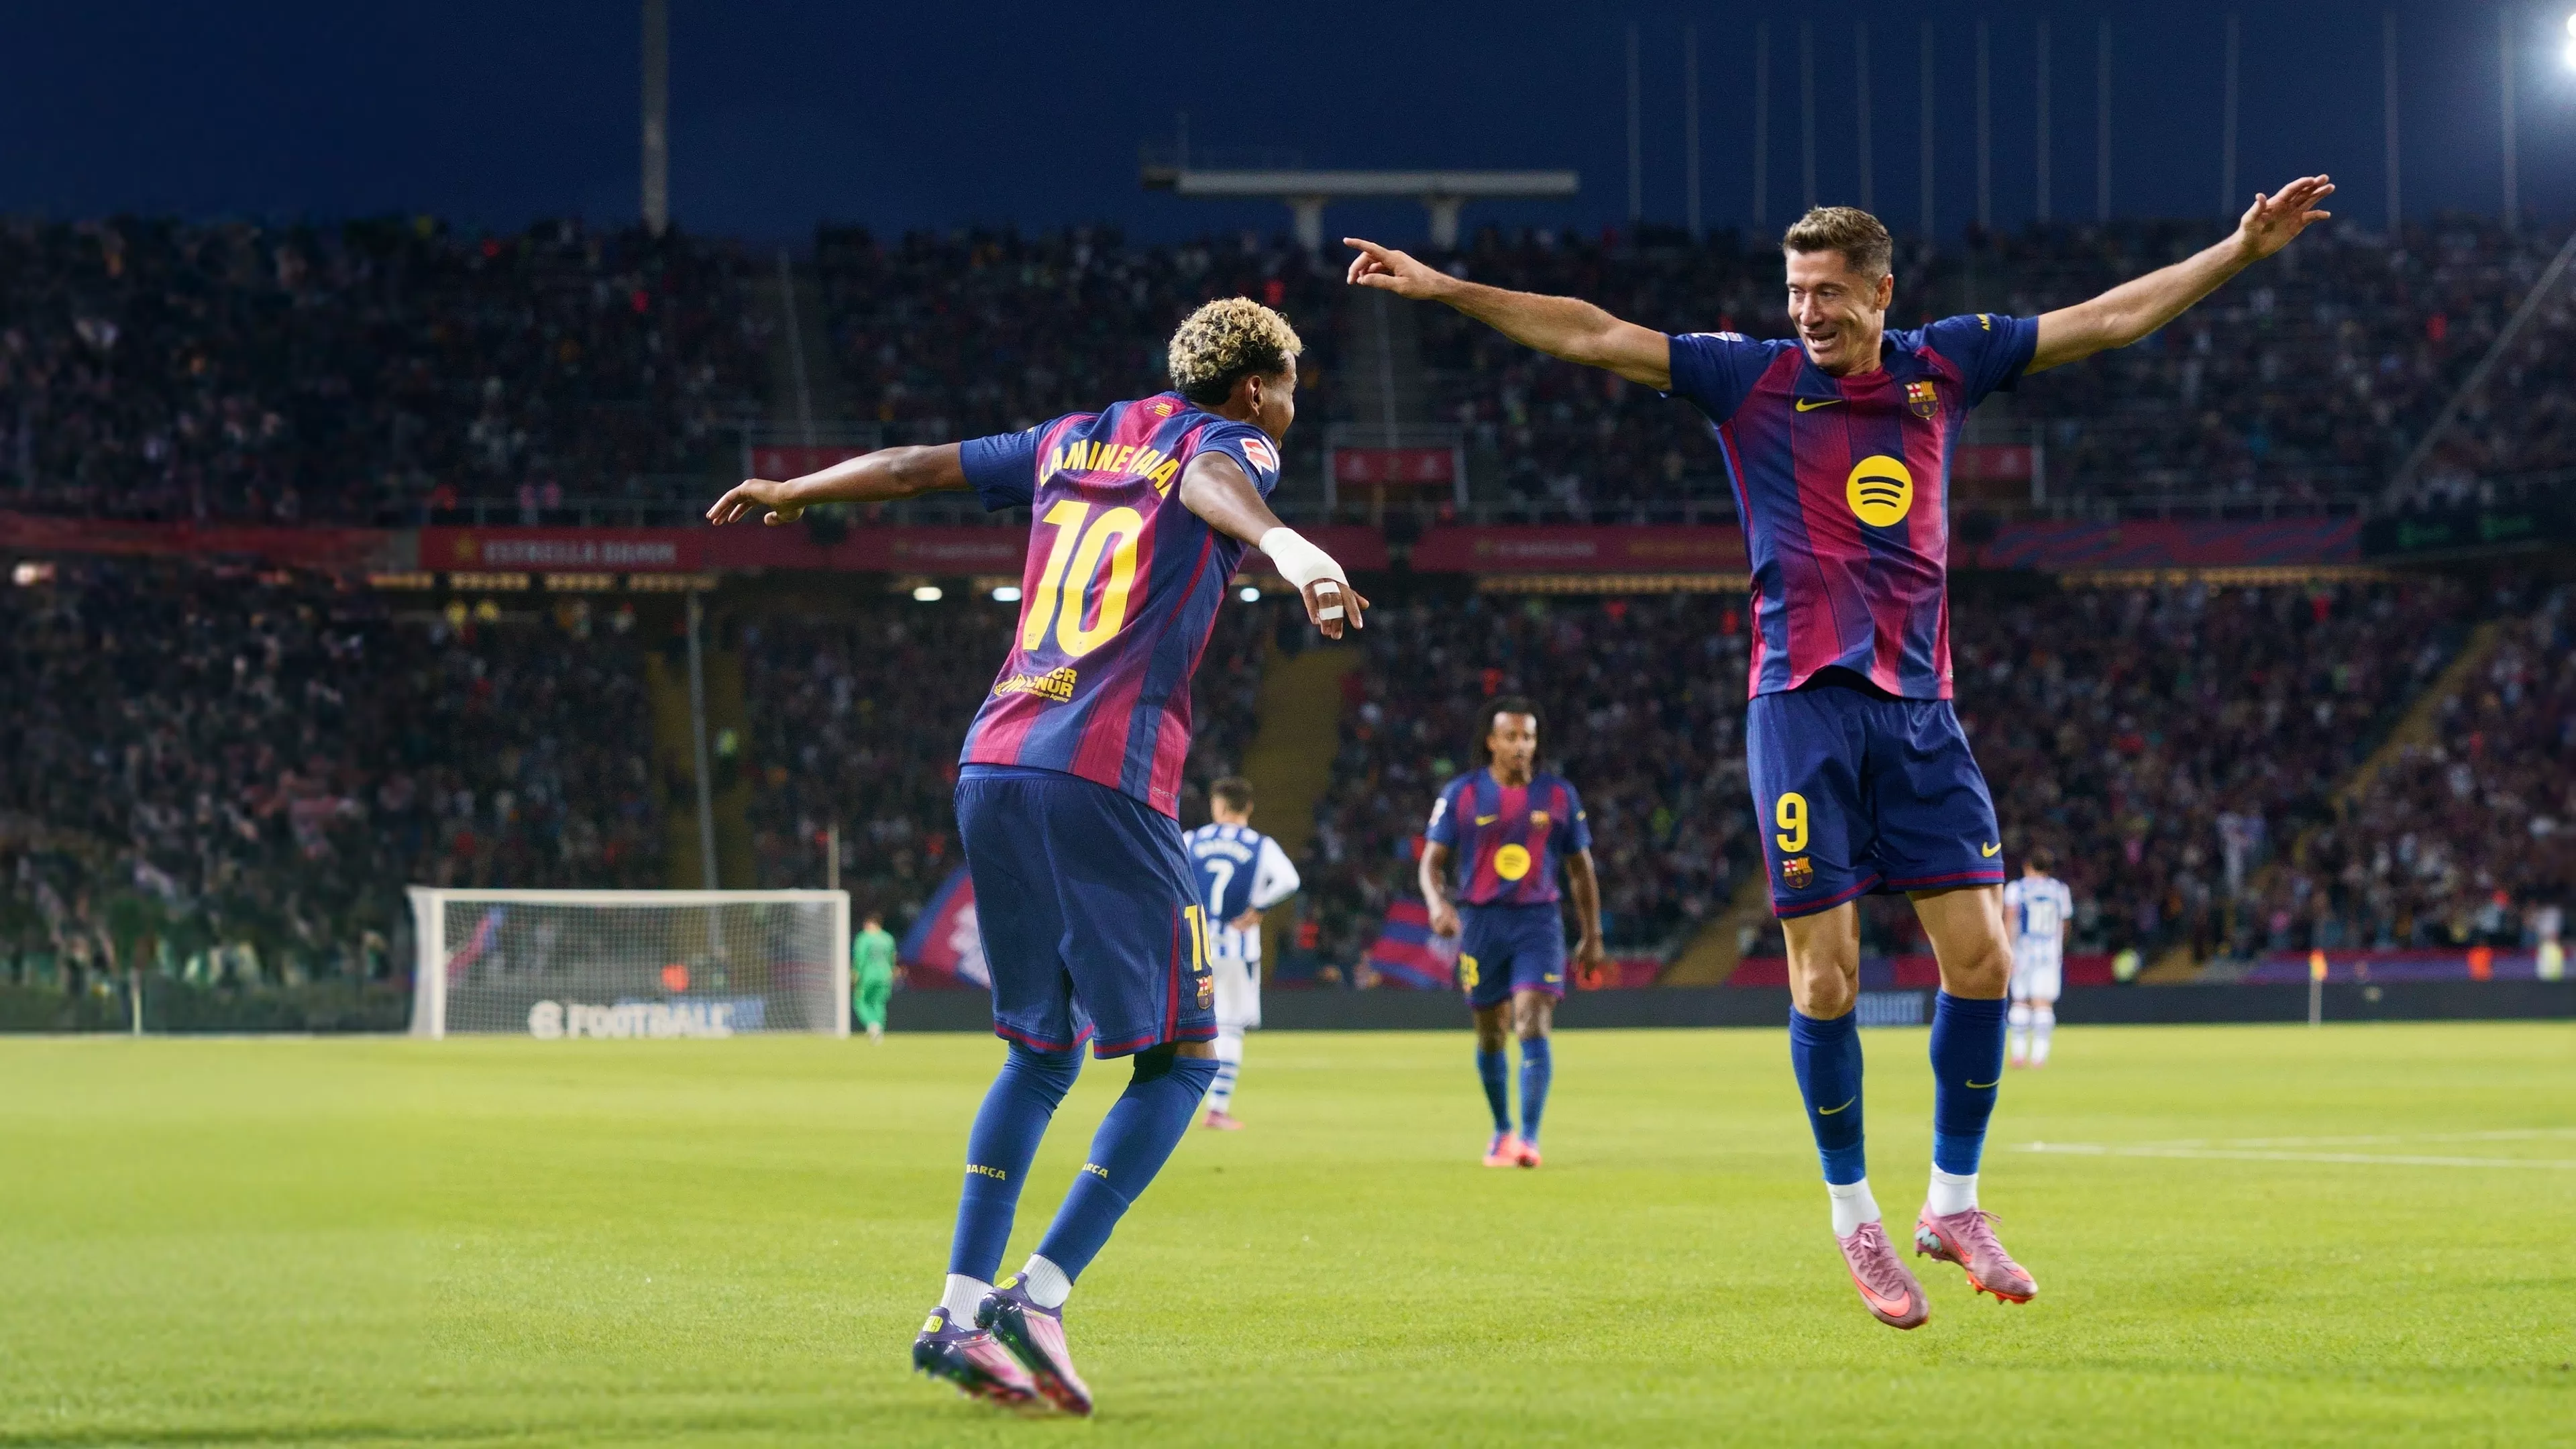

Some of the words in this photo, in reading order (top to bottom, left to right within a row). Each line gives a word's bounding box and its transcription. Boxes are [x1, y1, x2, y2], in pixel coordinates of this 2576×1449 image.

[1040, 439, 1135, 487] LAMINE
[1022, 499, 1144, 657] 10
[1776, 792, 1809, 853] 9
[1205, 858, 1235, 916] 7
[567, 1002, 734, 1038] FOOTBALL
